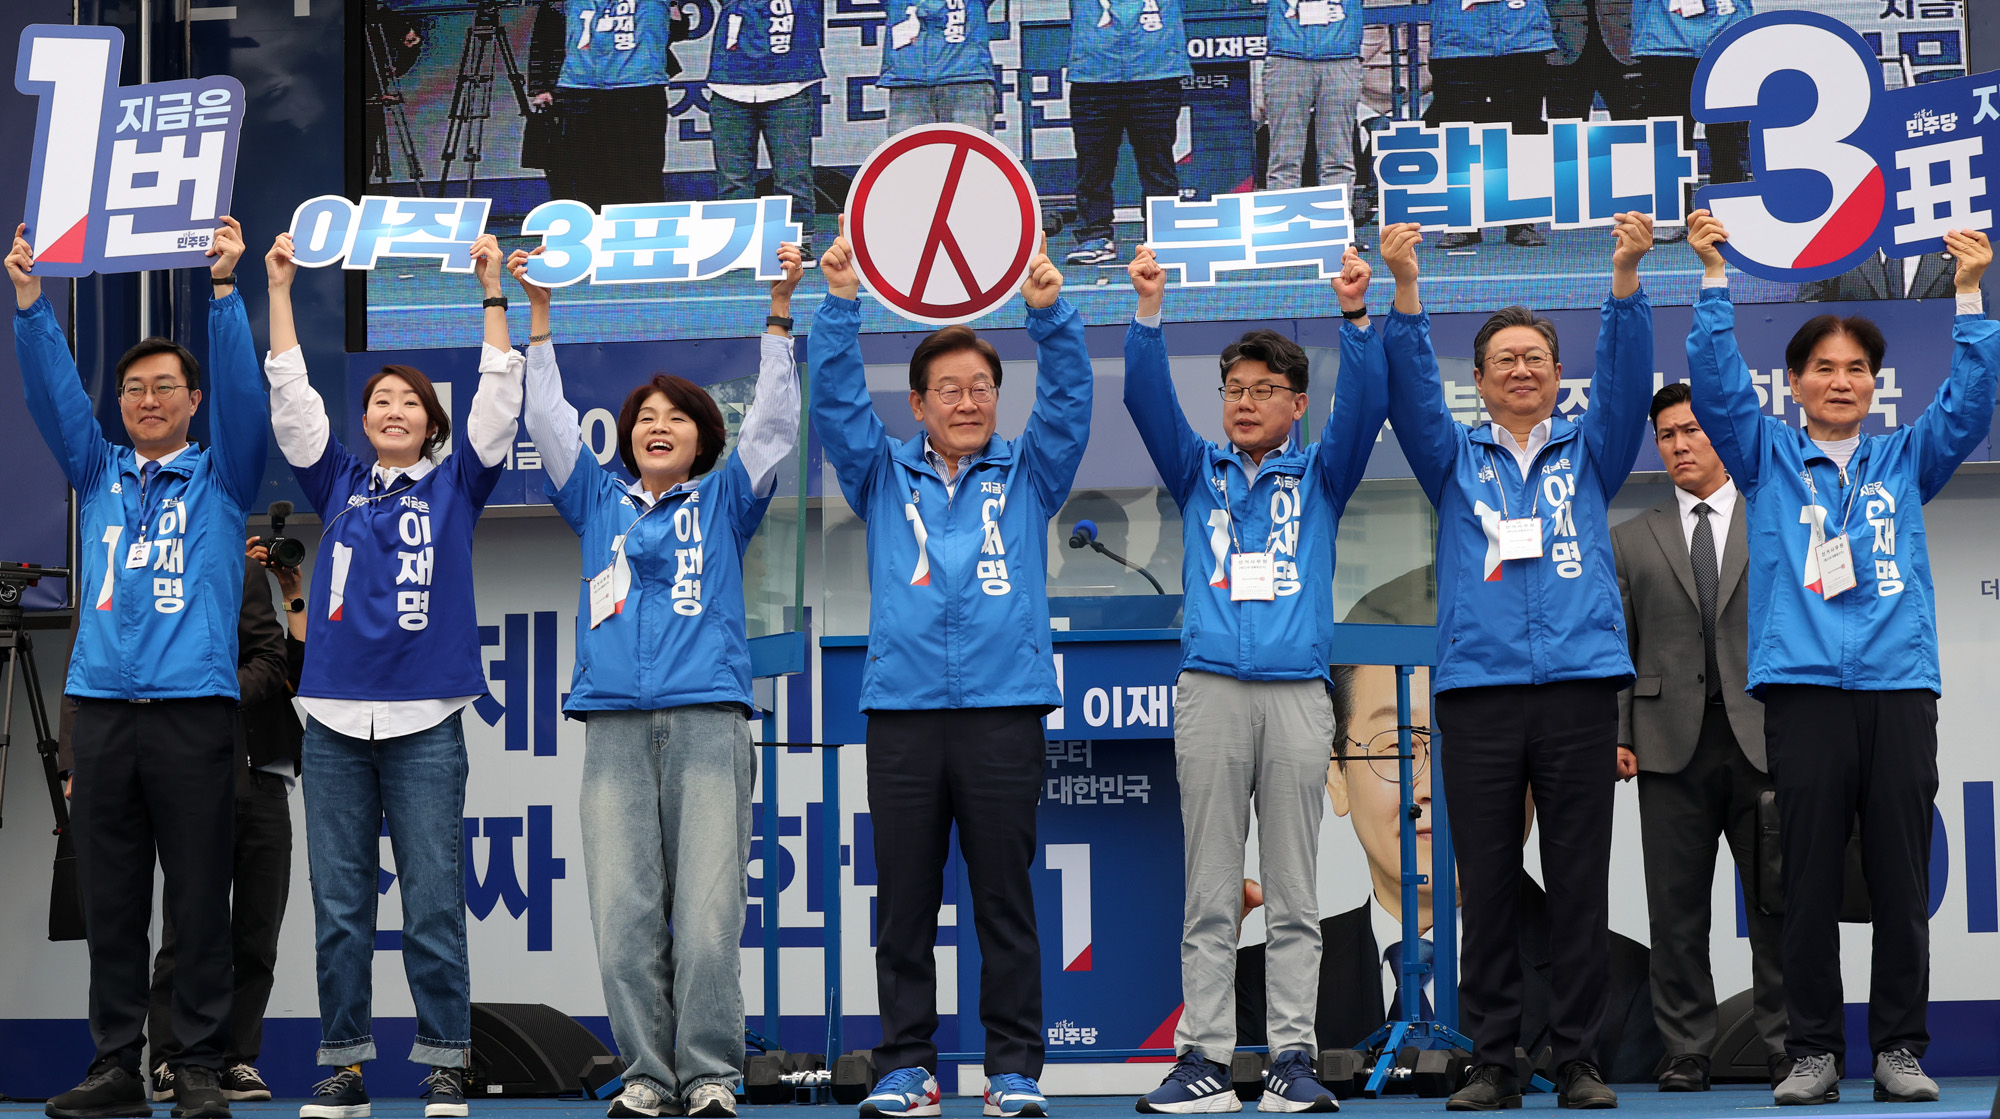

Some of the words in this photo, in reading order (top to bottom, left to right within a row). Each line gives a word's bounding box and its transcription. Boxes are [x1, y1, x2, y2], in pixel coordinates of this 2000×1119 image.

[1187, 36, 1268, 58] 이재명
[116, 89, 231, 133] 지금은
[1906, 113, 1958, 138] 민주당
[294, 198, 486, 271] 아직
[525, 198, 798, 284] 3표가
[1151, 188, 1349, 282] 부족
[1377, 120, 1692, 228] 합니다
[177, 235, 210, 249] 민주당
[400, 495, 430, 514] 지금은
[1543, 473, 1583, 579] 이재명
[153, 500, 187, 614] 이재명
[671, 506, 704, 617] 이재명
[1270, 486, 1302, 597] 이재명
[1865, 486, 1905, 597] 이재명
[395, 511, 435, 632] 이재명
[1981, 578, 2000, 600] 더
[1083, 685, 1177, 729] 이재
[1047, 774, 1151, 805] 대한민국
[1045, 843, 1092, 971] 1
[1048, 1027, 1098, 1045] 민주당
